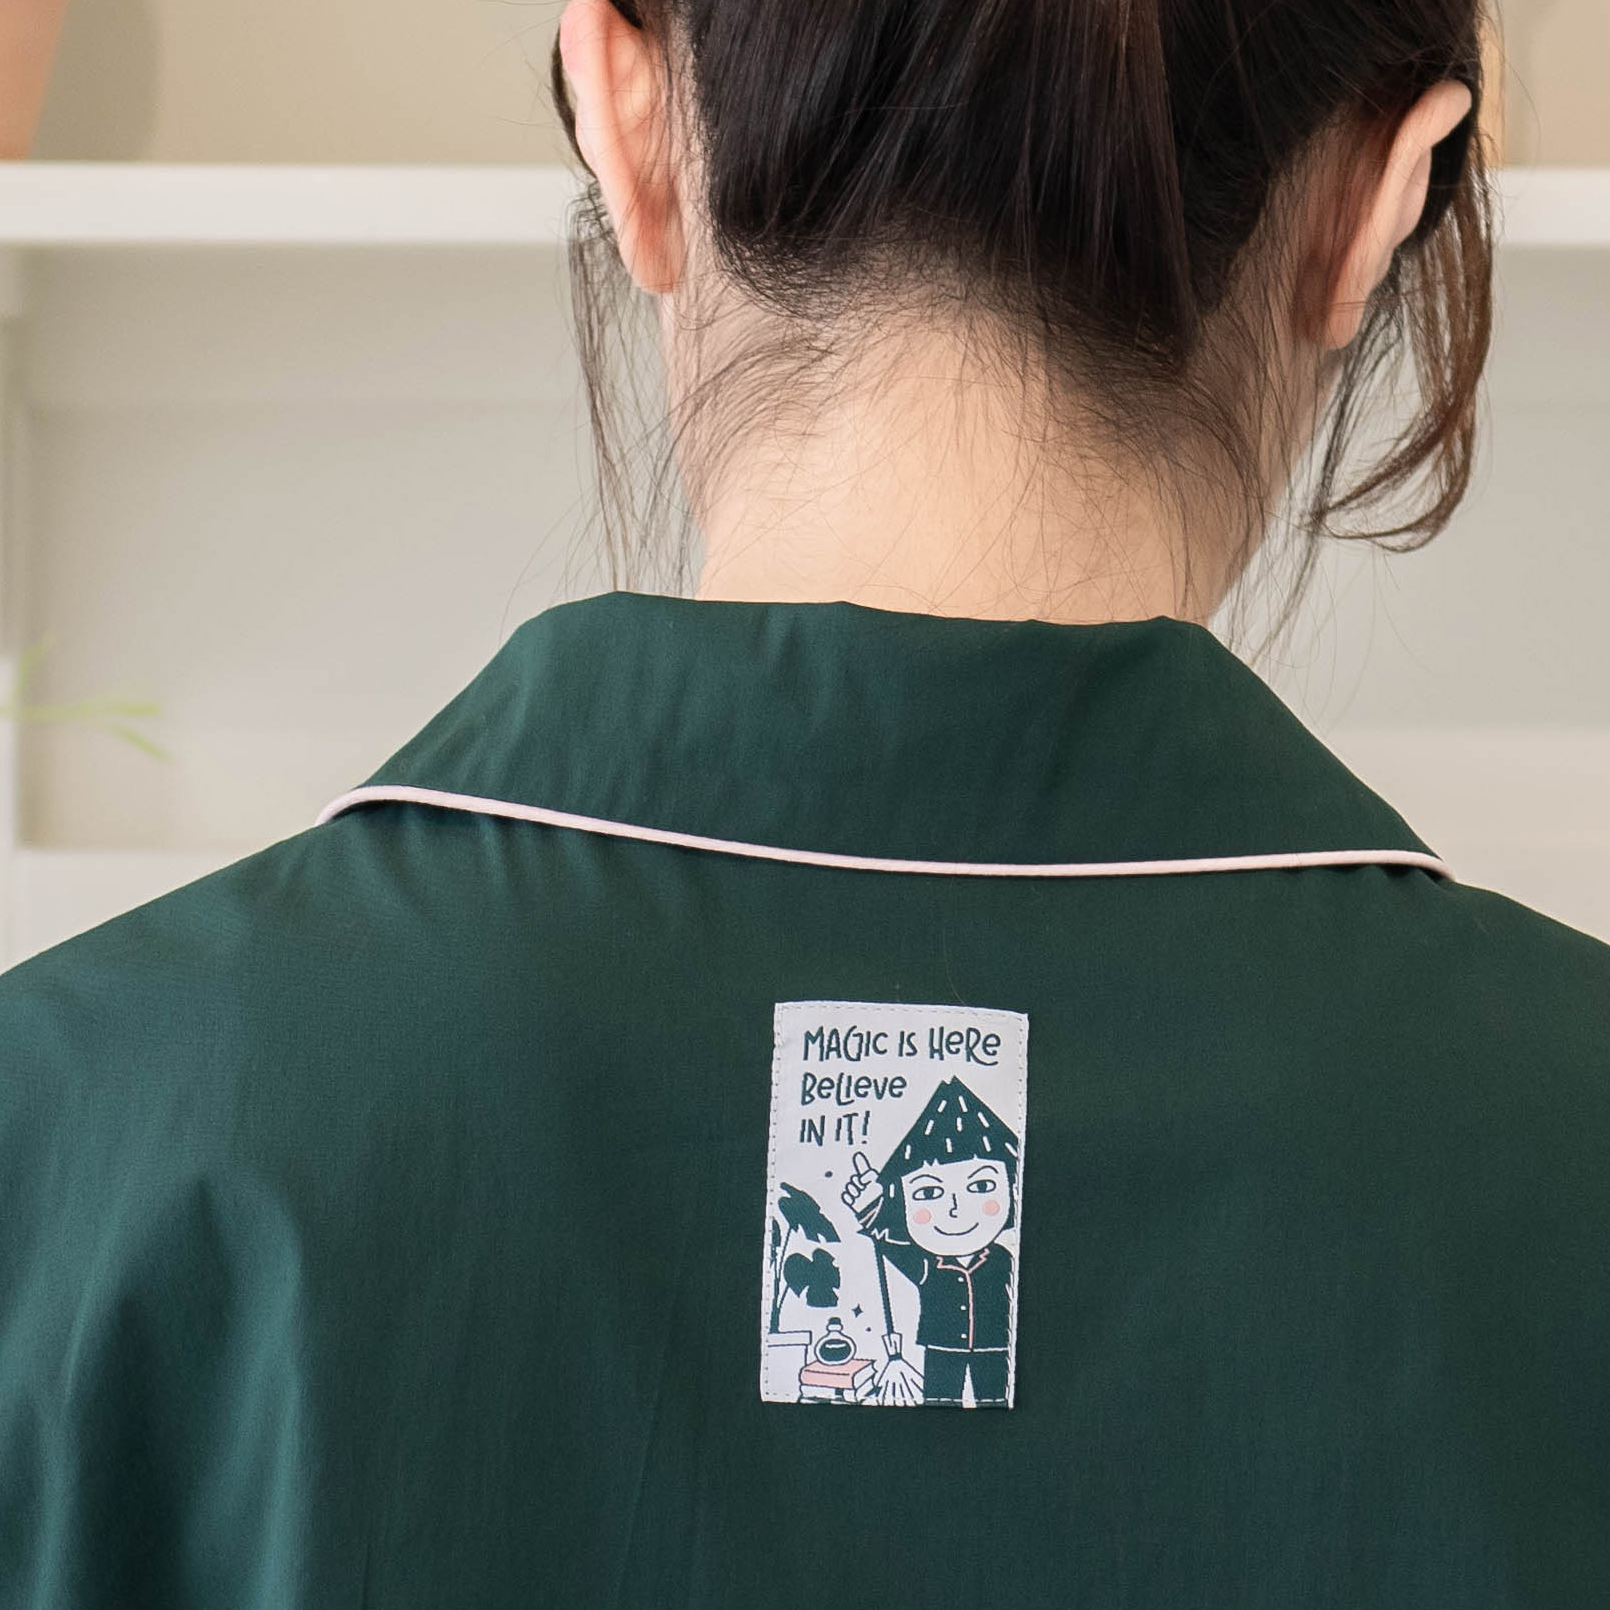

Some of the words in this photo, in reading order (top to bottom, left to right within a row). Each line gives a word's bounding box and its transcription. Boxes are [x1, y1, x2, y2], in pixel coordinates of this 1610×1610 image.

[803, 1025, 889, 1062] MAGIC
[897, 1030, 918, 1058] IS
[799, 1114, 826, 1147] IN
[835, 1110, 871, 1146] IT!
